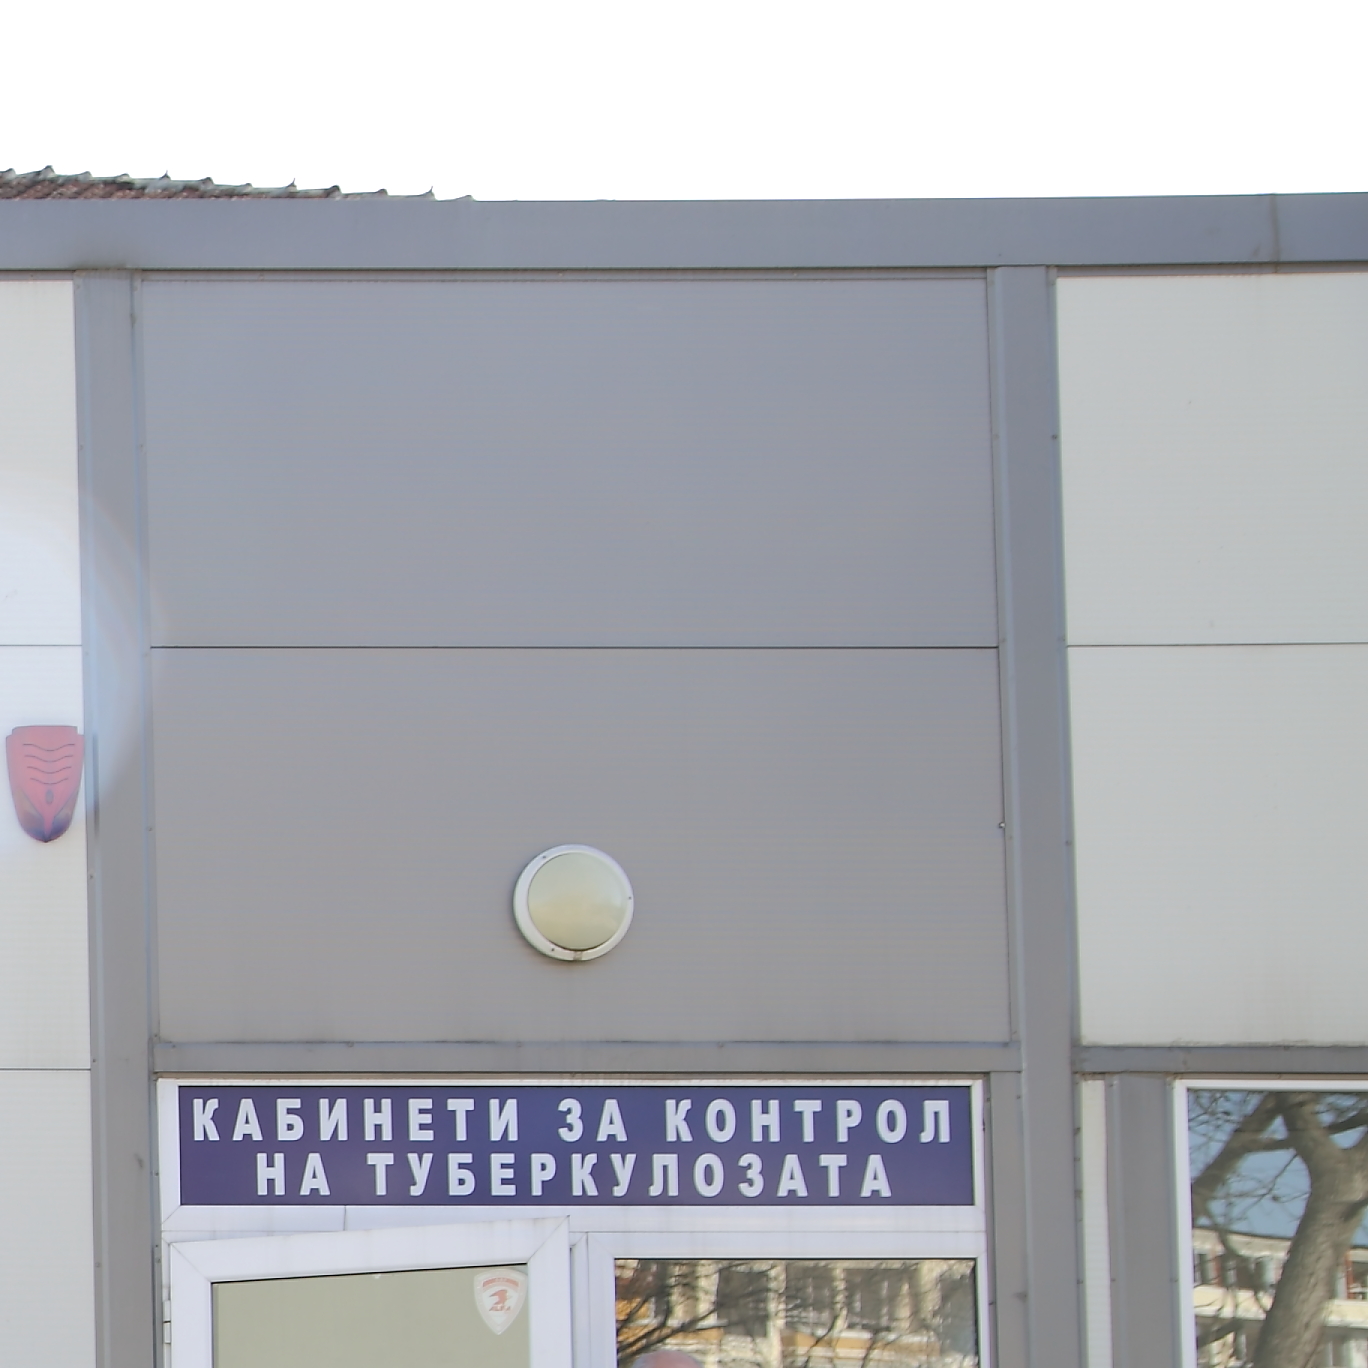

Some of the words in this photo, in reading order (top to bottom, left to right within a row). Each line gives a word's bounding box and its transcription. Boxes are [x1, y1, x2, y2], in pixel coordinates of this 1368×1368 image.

[192, 1097, 520, 1143] КАБИНЕТИ
[557, 1097, 629, 1143] ЗА
[664, 1097, 952, 1144] КОНТРОЛ
[255, 1151, 332, 1197] НА
[365, 1151, 893, 1199] ТУБЕРКУЛОЗАТА
